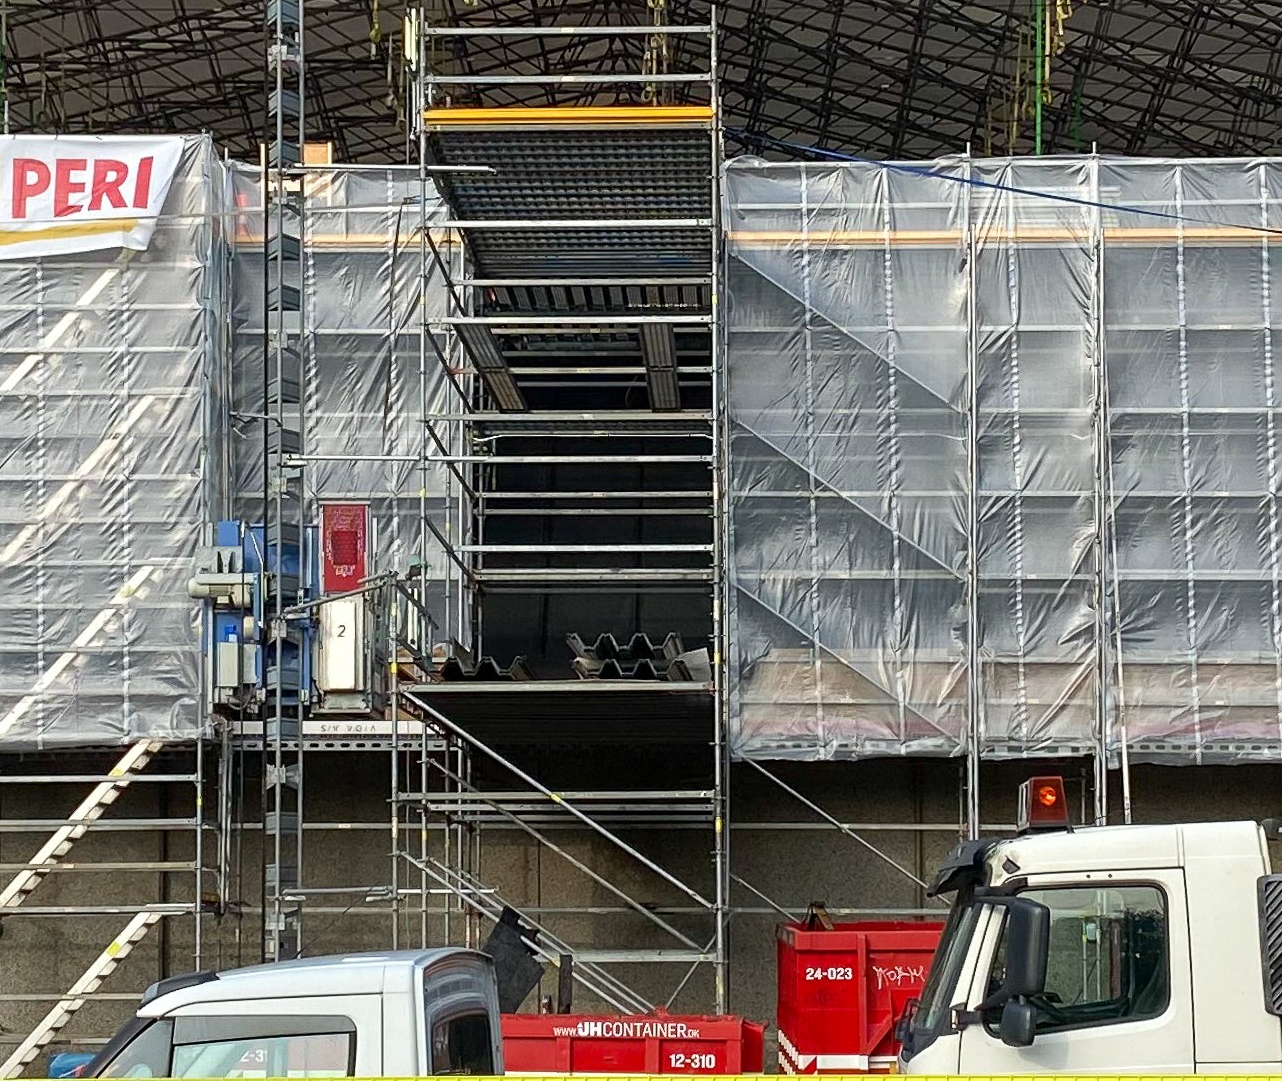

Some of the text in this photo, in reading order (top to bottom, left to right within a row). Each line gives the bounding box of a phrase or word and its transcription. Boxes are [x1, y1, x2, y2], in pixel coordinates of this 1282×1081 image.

[12, 156, 154, 218] PERI
[336, 624, 346, 637] 2
[805, 967, 853, 981] 24-023
[669, 1053, 716, 1069] 12-310
